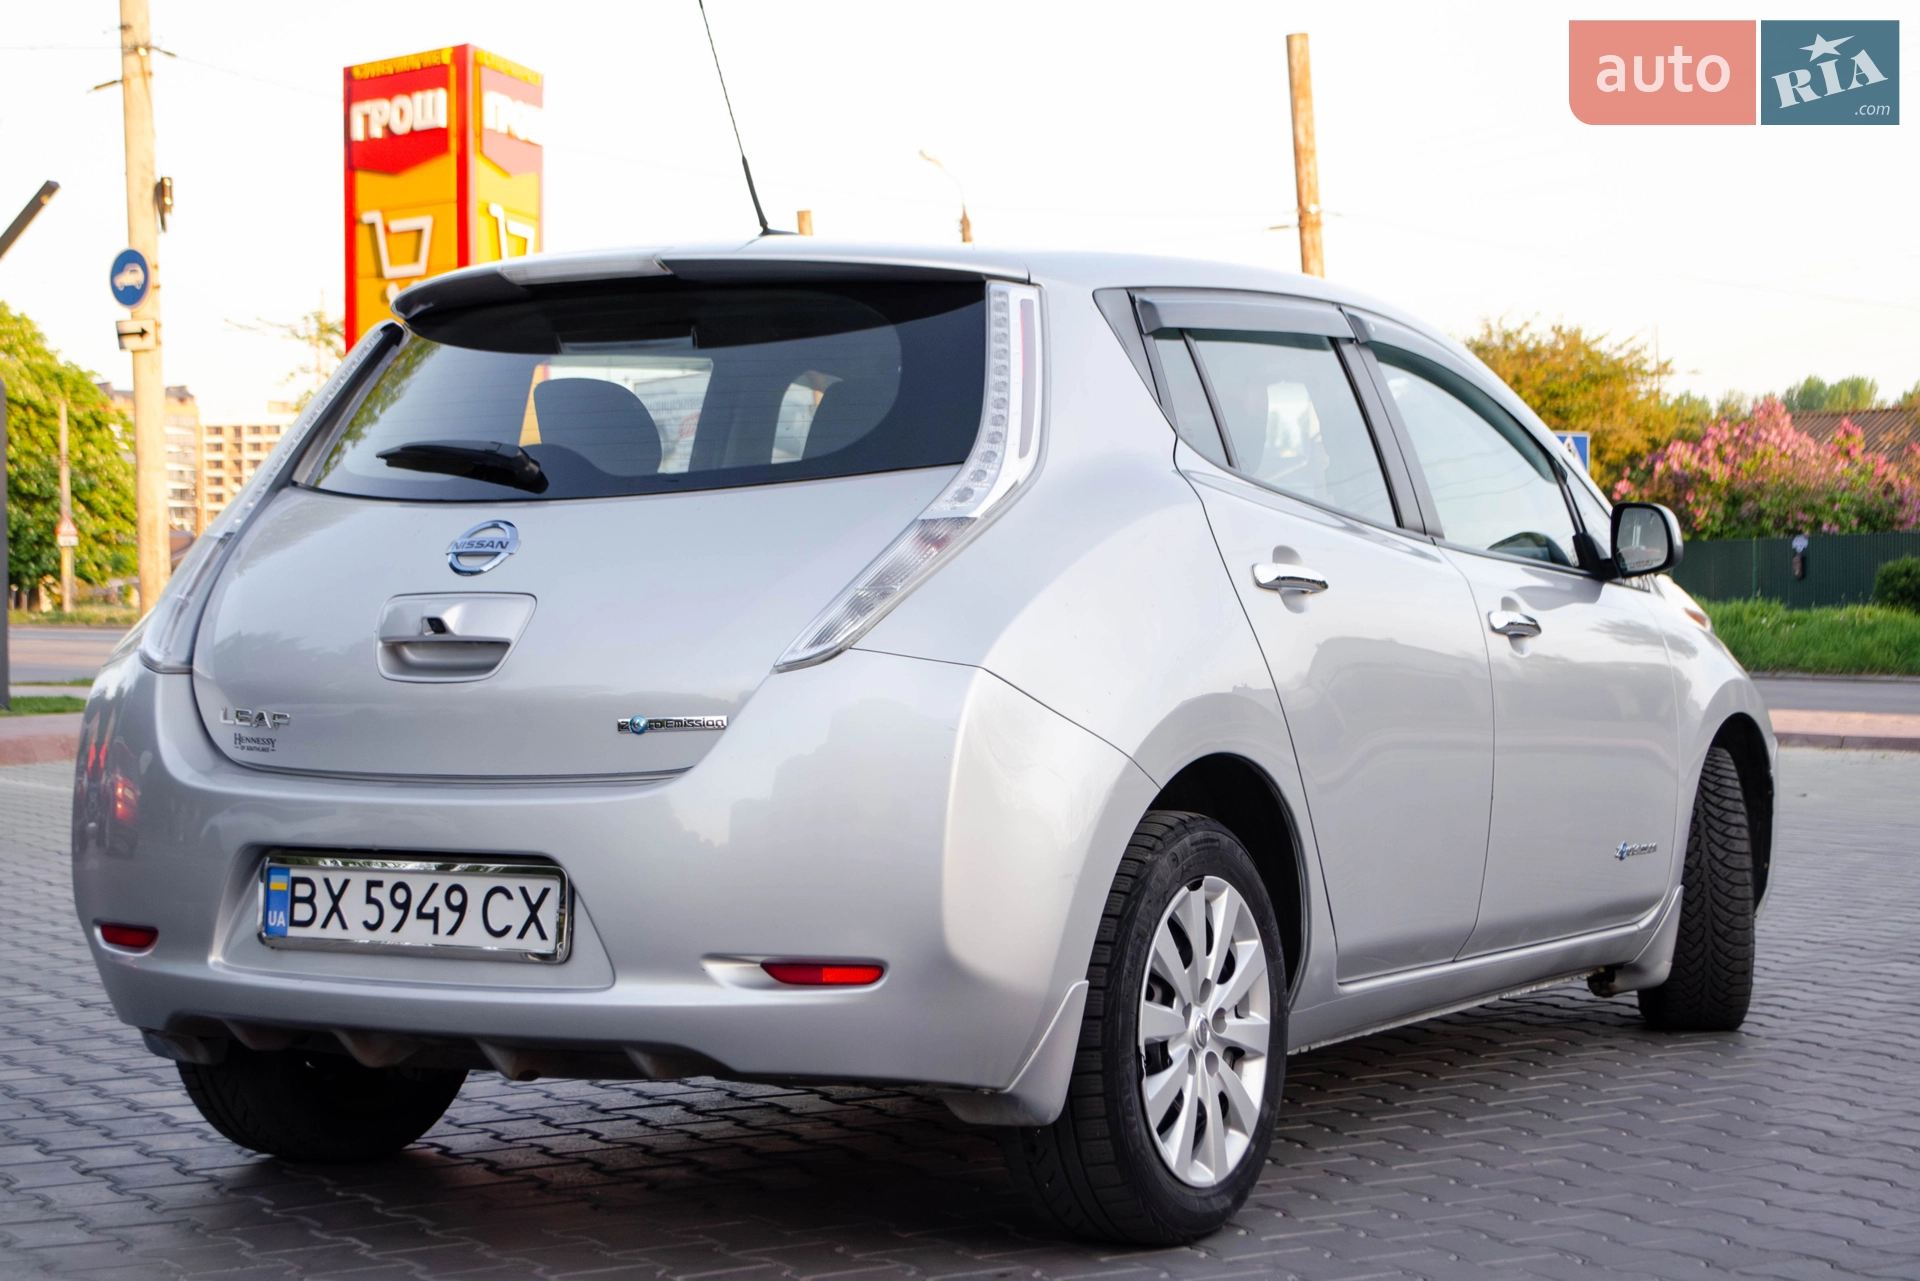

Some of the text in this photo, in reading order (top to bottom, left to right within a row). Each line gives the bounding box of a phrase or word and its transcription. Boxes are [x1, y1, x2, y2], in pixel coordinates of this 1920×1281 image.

[350, 87, 448, 142] ГРОШ
[451, 540, 510, 551] NISSAN
[220, 707, 290, 730] LEAF
[268, 910, 286, 928] UA
[288, 876, 552, 941] BX 5949 CX
